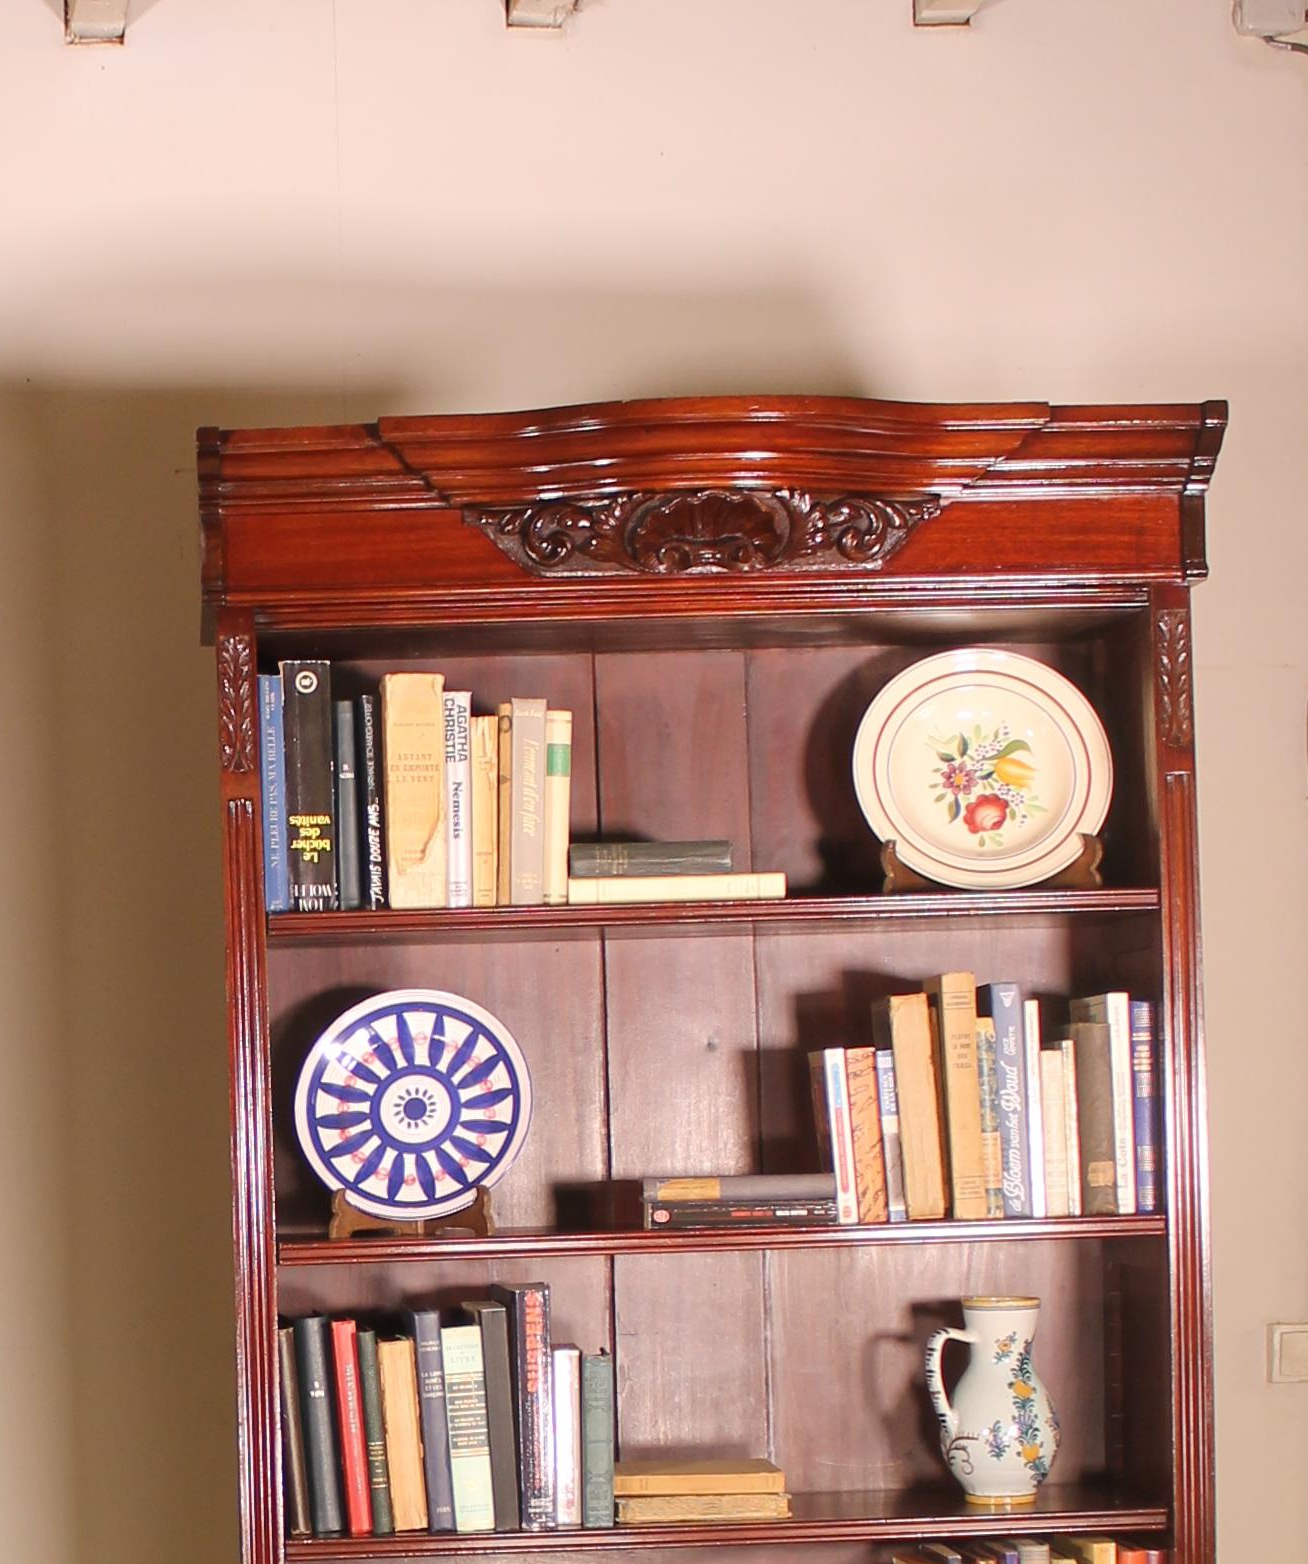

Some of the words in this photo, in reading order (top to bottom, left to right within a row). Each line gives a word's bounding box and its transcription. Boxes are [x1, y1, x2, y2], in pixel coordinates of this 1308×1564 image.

[266, 726, 277, 760] BELLE
[444, 698, 456, 764] CHRISTIE
[456, 704, 468, 763] AGATHA
[267, 763, 278, 780] MA
[411, 775, 436, 783] VENT
[288, 815, 331, 826] vanités
[452, 781, 464, 840] Nemesis
[269, 806, 280, 849] PLEURE
[299, 827, 321, 838] des
[290, 838, 330, 851] bûcher
[370, 829, 382, 863] DOUZE
[270, 852, 280, 868] NE
[303, 852, 318, 863] Le
[298, 899, 324, 912] TOM
[1000, 1061, 1021, 1112] Woud
[1002, 1149, 1024, 1201] Bloem
